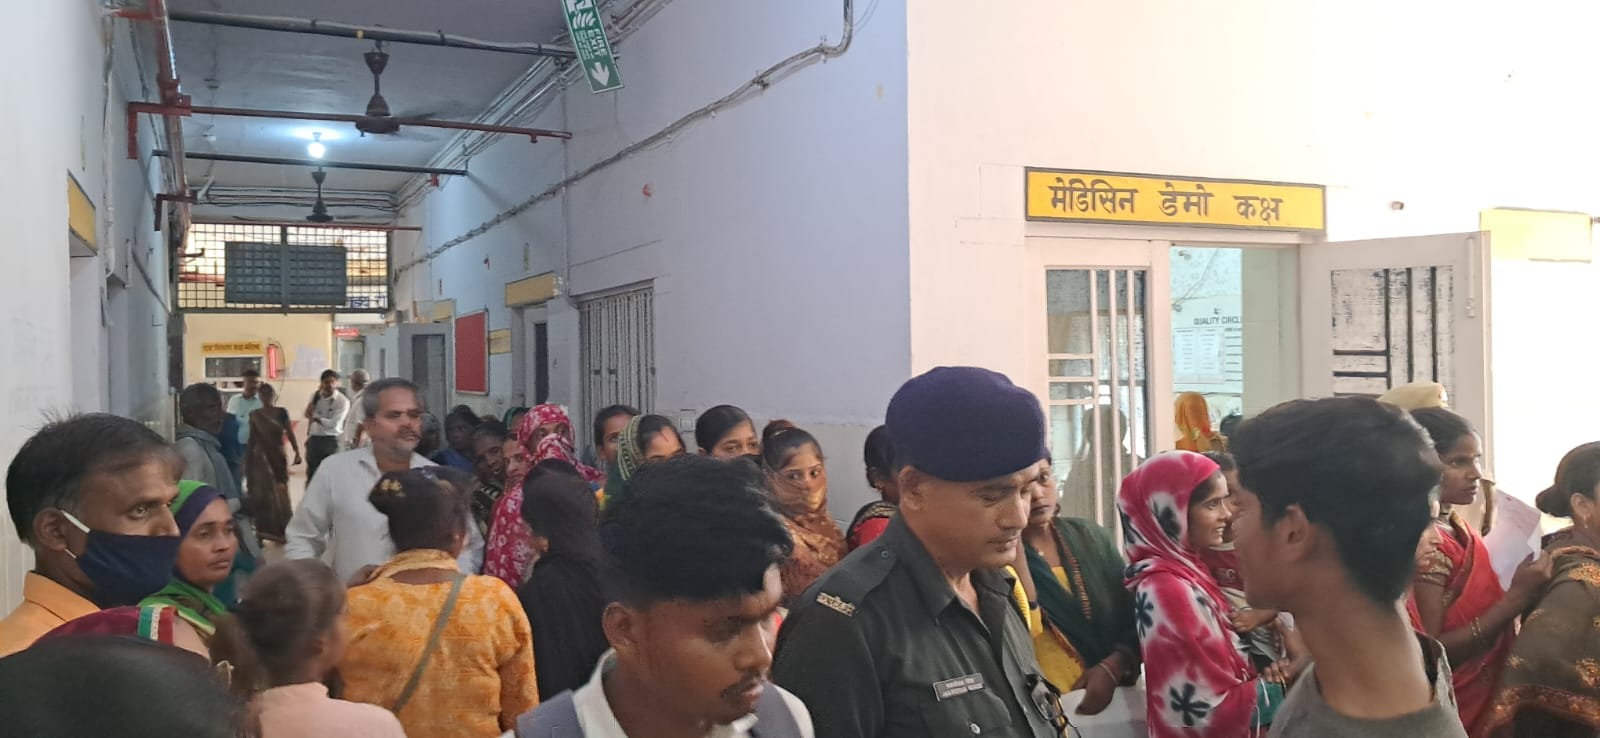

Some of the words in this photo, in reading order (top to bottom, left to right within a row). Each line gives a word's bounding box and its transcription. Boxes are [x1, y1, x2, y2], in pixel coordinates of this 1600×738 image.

[587, 29, 601, 56] EXIT
[594, 28, 608, 57] FIRE
[1048, 177, 1139, 215] मेडिसिन
[1158, 182, 1214, 217] डेमो
[1233, 194, 1284, 225] कक्ष
[1193, 317, 1220, 325] QUALITY
[1221, 316, 1241, 324] CIRCL
